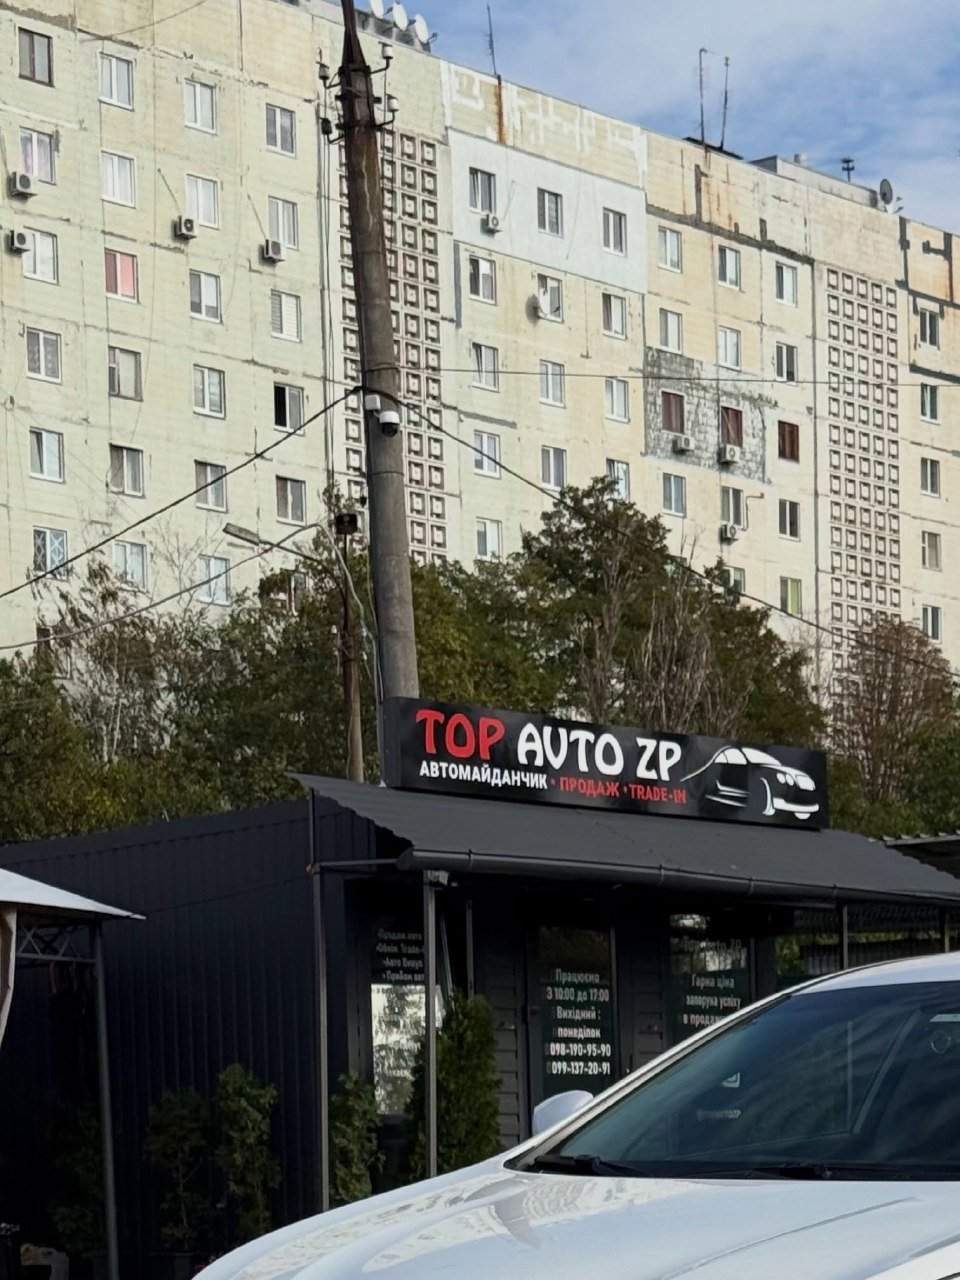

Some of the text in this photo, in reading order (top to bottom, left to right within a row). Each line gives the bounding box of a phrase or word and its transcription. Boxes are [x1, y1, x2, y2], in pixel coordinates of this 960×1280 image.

[415, 708, 505, 760] TOP
[635, 736, 682, 782] ZP
[419, 760, 687, 804] АВТОМАЙДАНЧИК ПРОДАЖ TRADE-IN
[577, 990, 588, 1003] до
[557, 1005, 596, 1021] Вихідний
[550, 1042, 611, 1058] 098-190-95-90
[552, 1061, 611, 1075] 099-137-20-91
